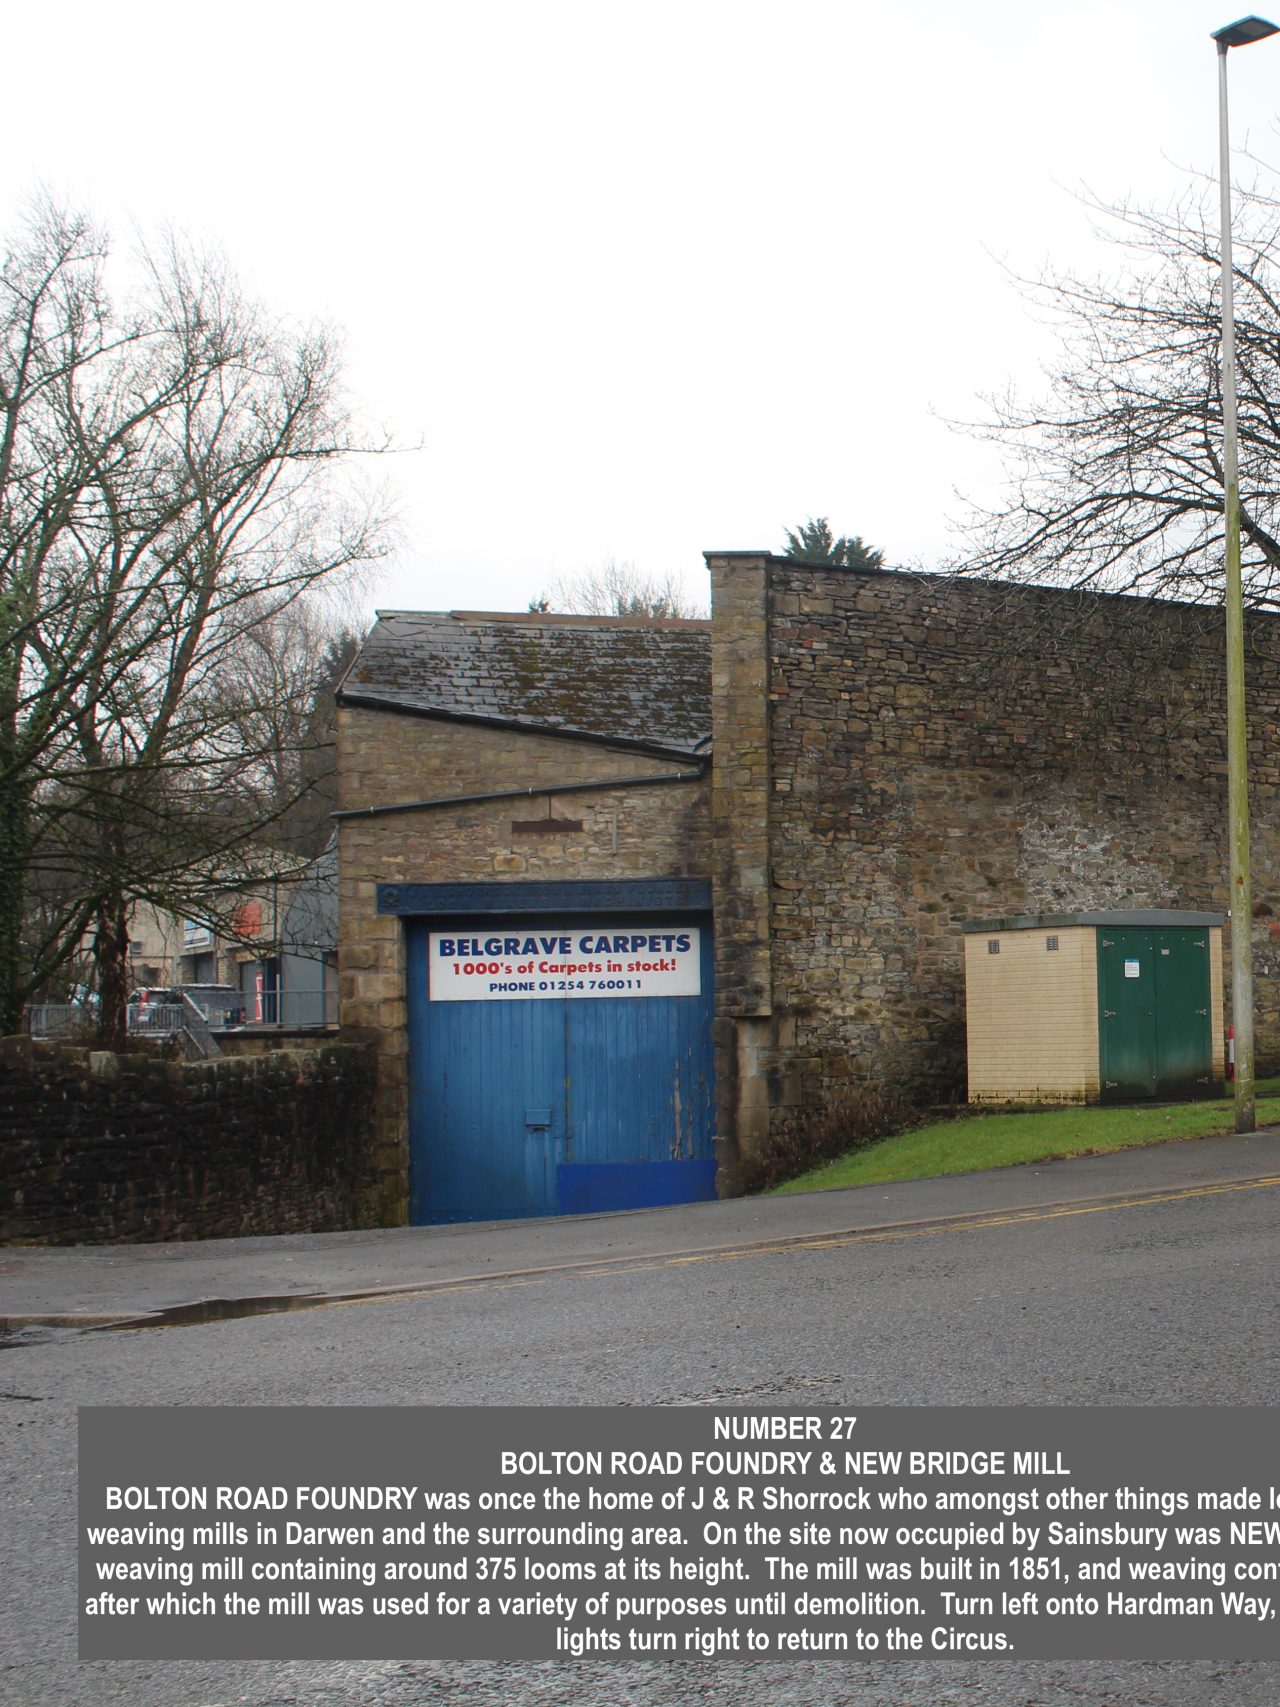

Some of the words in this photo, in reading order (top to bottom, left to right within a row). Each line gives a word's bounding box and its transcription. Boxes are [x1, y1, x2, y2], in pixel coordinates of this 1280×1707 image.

[439, 937, 572, 957] BELGRAVE
[579, 934, 691, 954] CARPETS
[453, 962, 513, 976] 1000's
[517, 961, 534, 974] of
[538, 960, 602, 976] Carpets
[607, 960, 622, 973] in
[627, 958, 677, 972] stock!
[489, 981, 535, 993] PHONE
[539, 980, 585, 991] 01254
[588, 979, 642, 990] 760011
